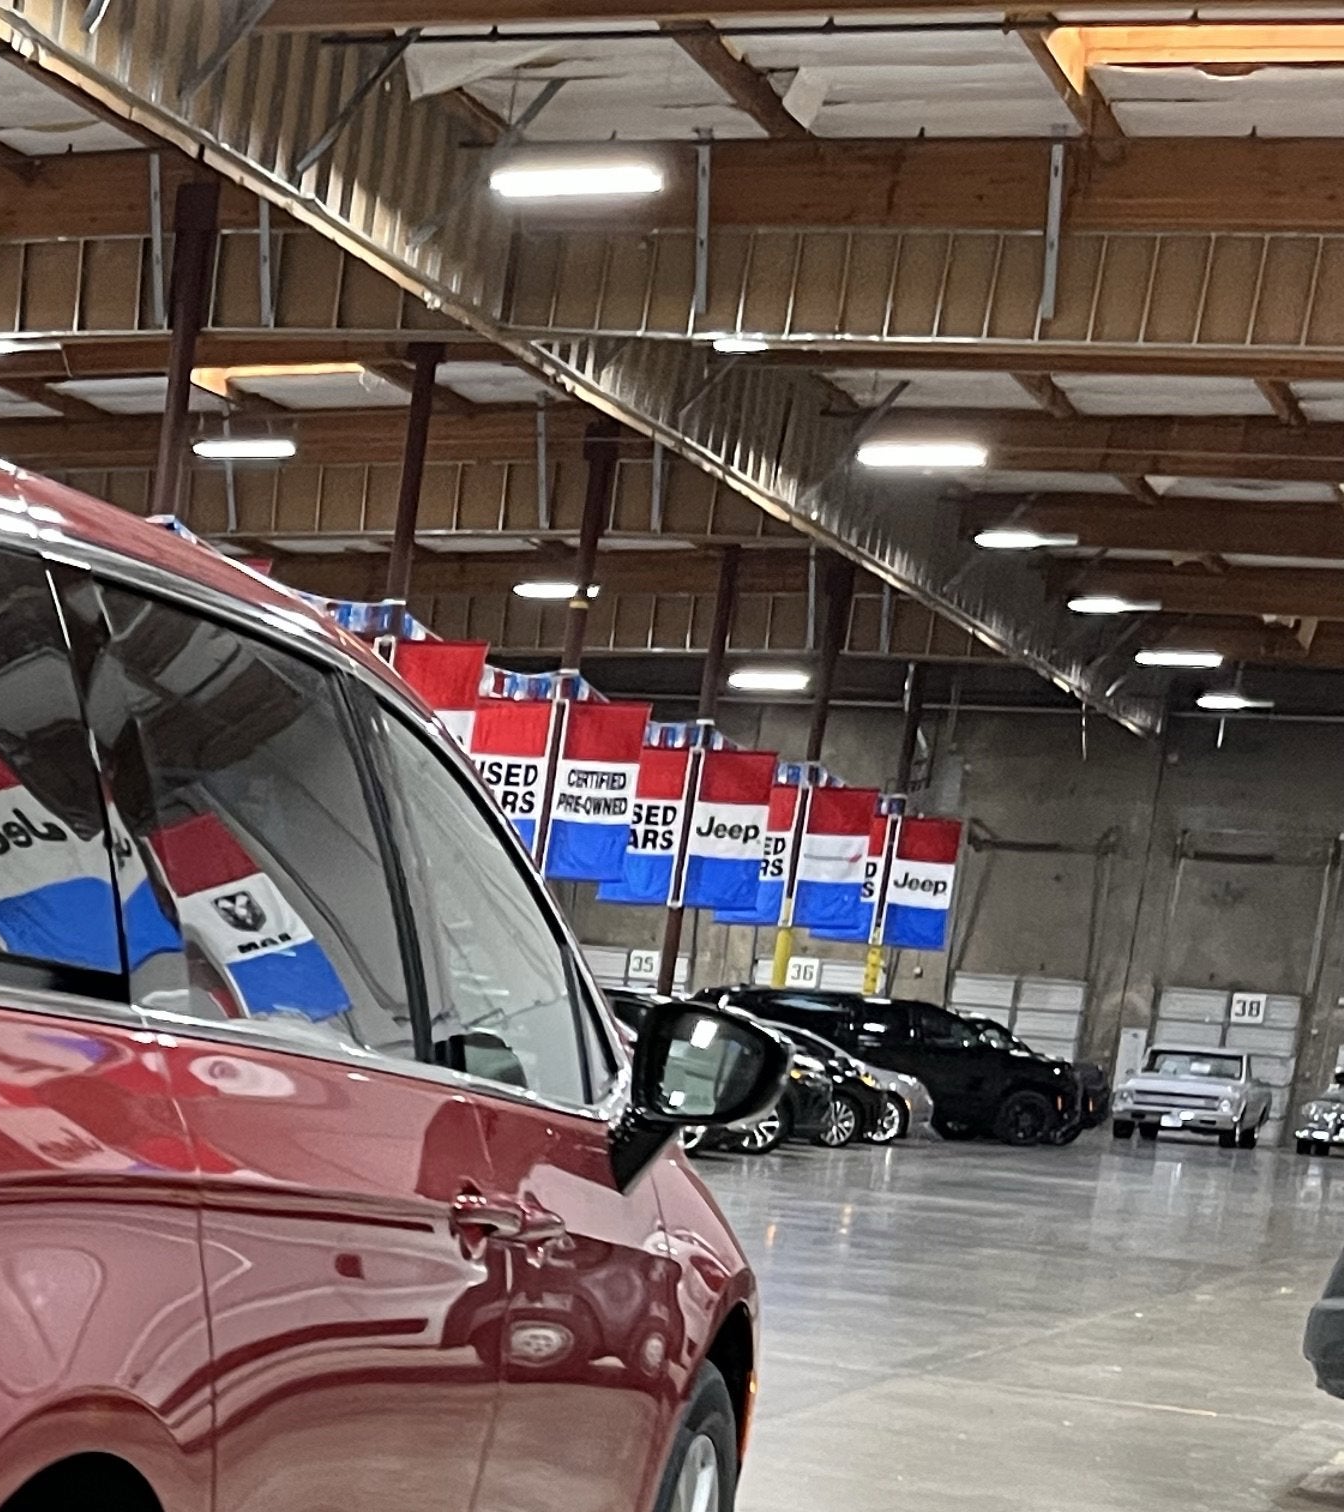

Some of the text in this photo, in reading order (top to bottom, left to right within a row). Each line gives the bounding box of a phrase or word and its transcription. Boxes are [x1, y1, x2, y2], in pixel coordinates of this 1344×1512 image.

[568, 769, 627, 791] CERTIFIED
[500, 790, 536, 814] RS
[556, 792, 628, 816] PRE-OWNED
[632, 803, 678, 827] SED
[628, 828, 675, 851] ARS
[696, 816, 760, 844] Jeep
[764, 837, 786, 855] ED
[760, 858, 784, 877] RS
[893, 872, 948, 896] Jeep
[633, 956, 654, 973] 35
[791, 963, 814, 981] 36
